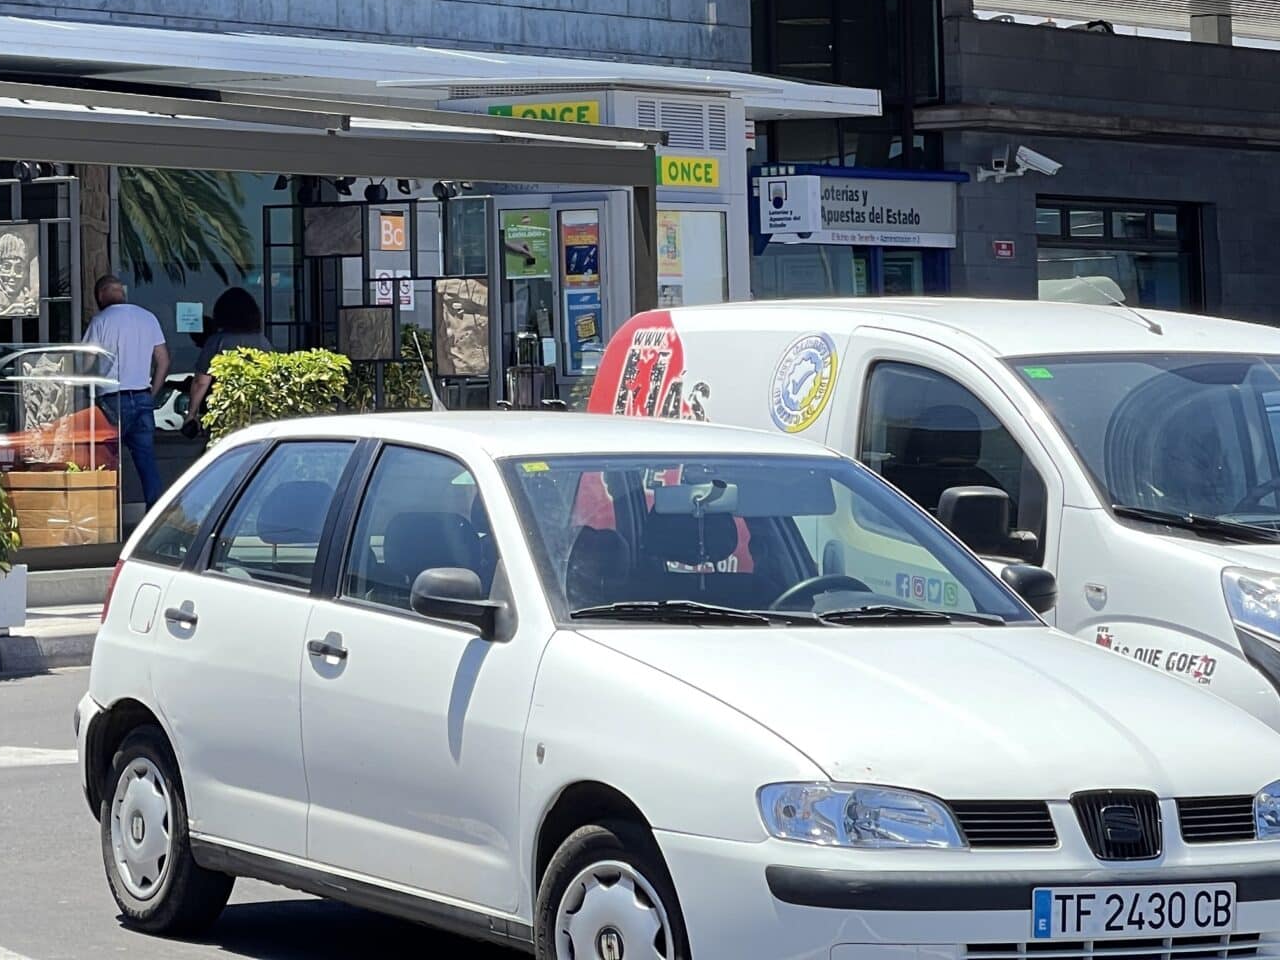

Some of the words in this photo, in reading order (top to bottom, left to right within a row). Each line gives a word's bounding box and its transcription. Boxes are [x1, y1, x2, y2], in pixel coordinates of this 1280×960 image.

[522, 105, 590, 124] ONCE
[667, 160, 714, 184] ONCE
[861, 189, 868, 207] y
[821, 205, 866, 225] Apuestas
[868, 206, 884, 224] del
[886, 208, 920, 226] Estado
[1054, 893, 1096, 933] TF
[1104, 891, 1186, 932] 2430
[1194, 889, 1232, 928] CB
[1038, 919, 1048, 930] E
